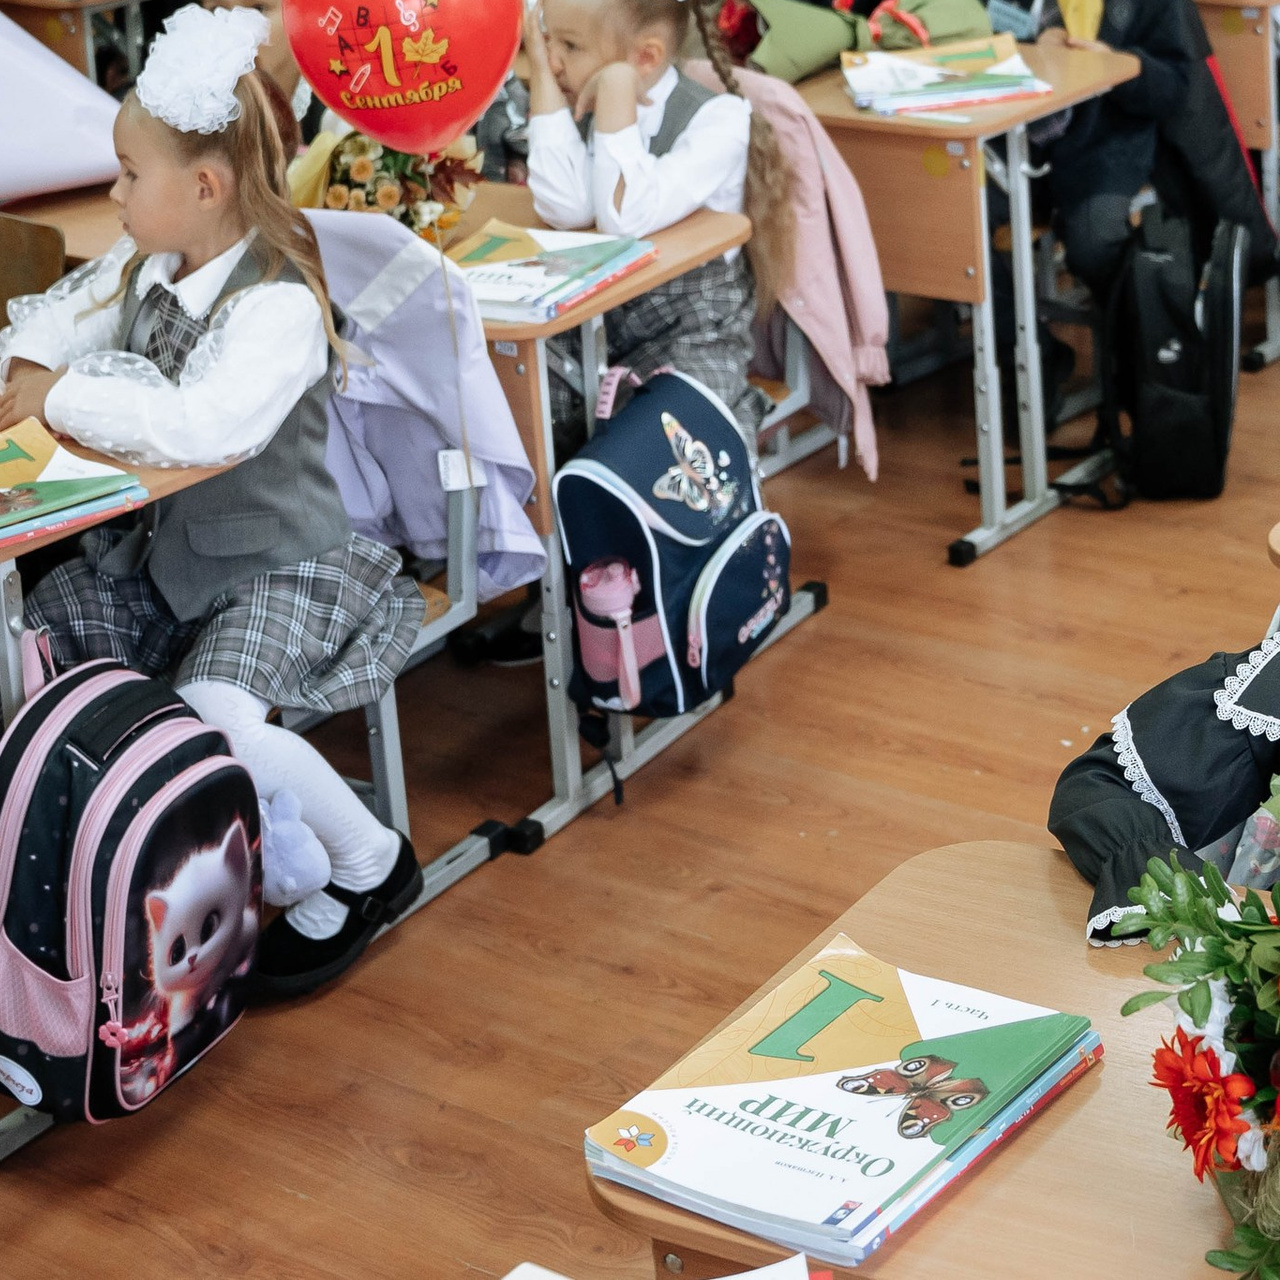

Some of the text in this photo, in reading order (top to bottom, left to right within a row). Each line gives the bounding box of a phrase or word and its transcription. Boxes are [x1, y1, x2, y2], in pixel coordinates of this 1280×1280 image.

[364, 25, 401, 87] 1
[340, 77, 463, 110] Сентября
[748, 969, 885, 1062] 1
[683, 1097, 895, 1178] Окружающий
[738, 1094, 858, 1139] МИР
